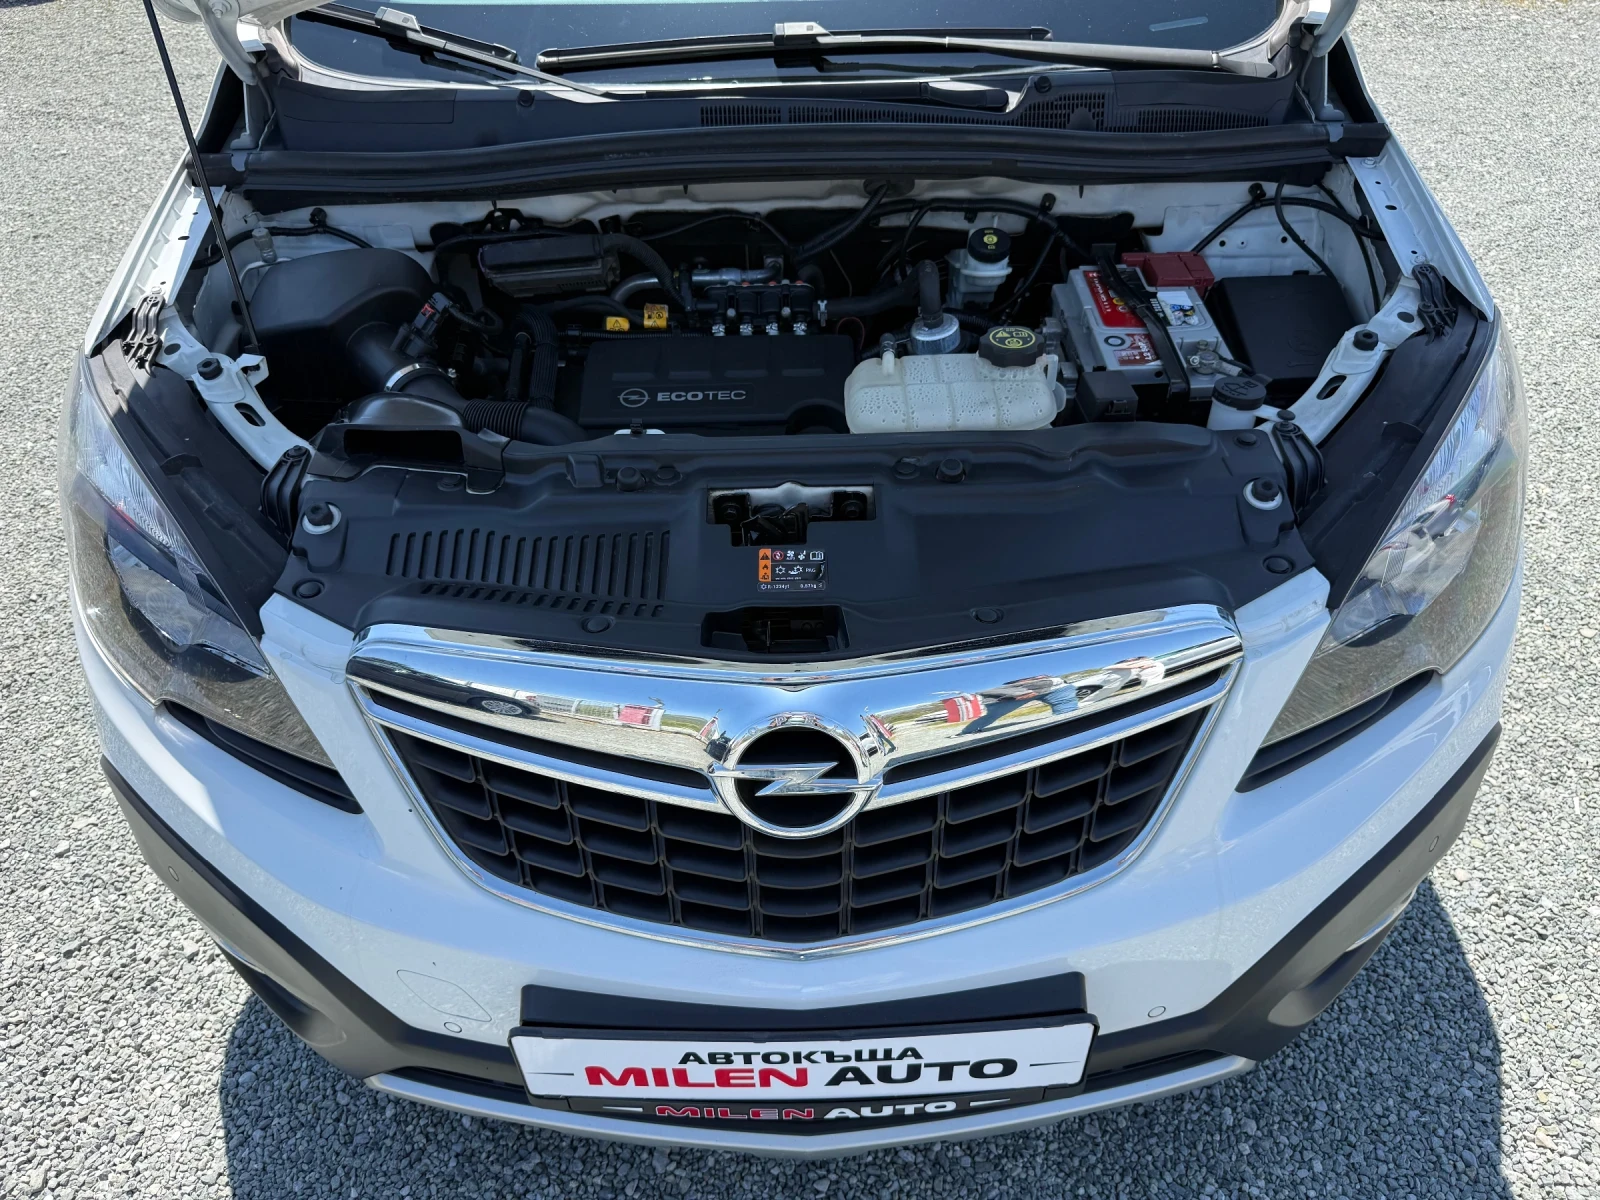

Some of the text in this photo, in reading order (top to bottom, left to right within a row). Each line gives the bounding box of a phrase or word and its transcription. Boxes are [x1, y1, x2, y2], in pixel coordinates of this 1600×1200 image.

[656, 389, 747, 402] ECOTEC
[584, 1057, 1018, 1088] MILEN AUTO
[655, 1100, 957, 1121] MILEN AUTO
